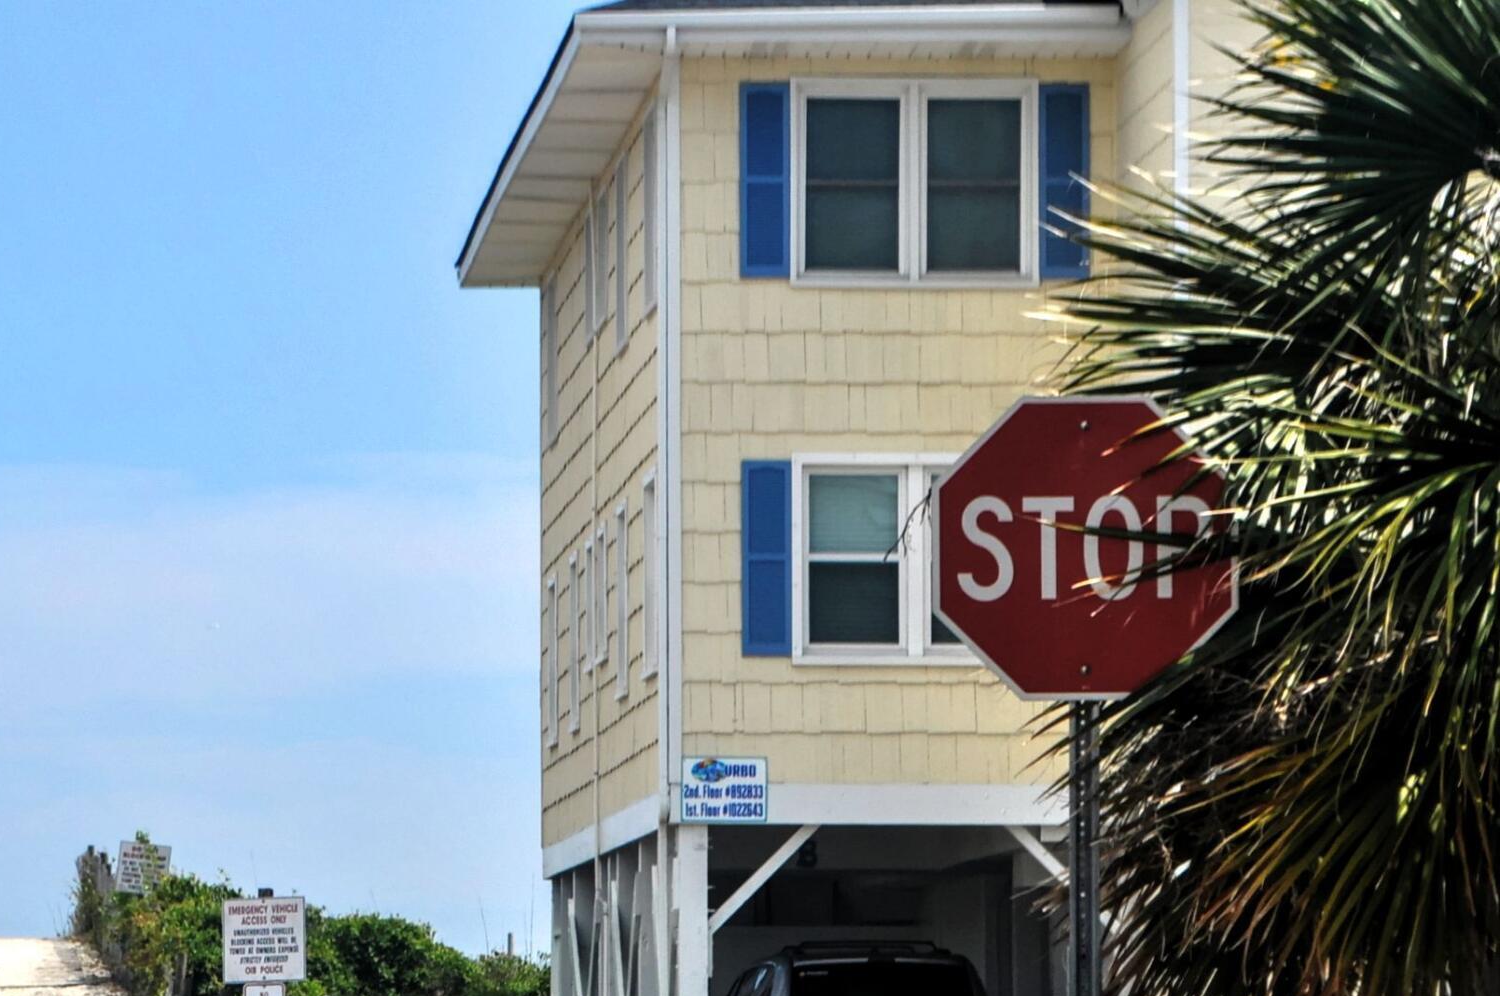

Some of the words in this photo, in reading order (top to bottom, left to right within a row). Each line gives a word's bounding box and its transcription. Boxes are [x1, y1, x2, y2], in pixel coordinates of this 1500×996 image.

[957, 495, 1214, 602] STOP
[703, 784, 723, 799] Floor
[701, 802, 720, 817] Floor
[228, 904, 268, 915] EMERGENCY
[271, 903, 298, 914] VEHICLE
[241, 916, 267, 926] ACCESS
[270, 915, 287, 924] ONLY
[257, 937, 275, 945] ACCESS
[245, 966, 256, 975] OIB
[260, 965, 283, 974] POLICE
